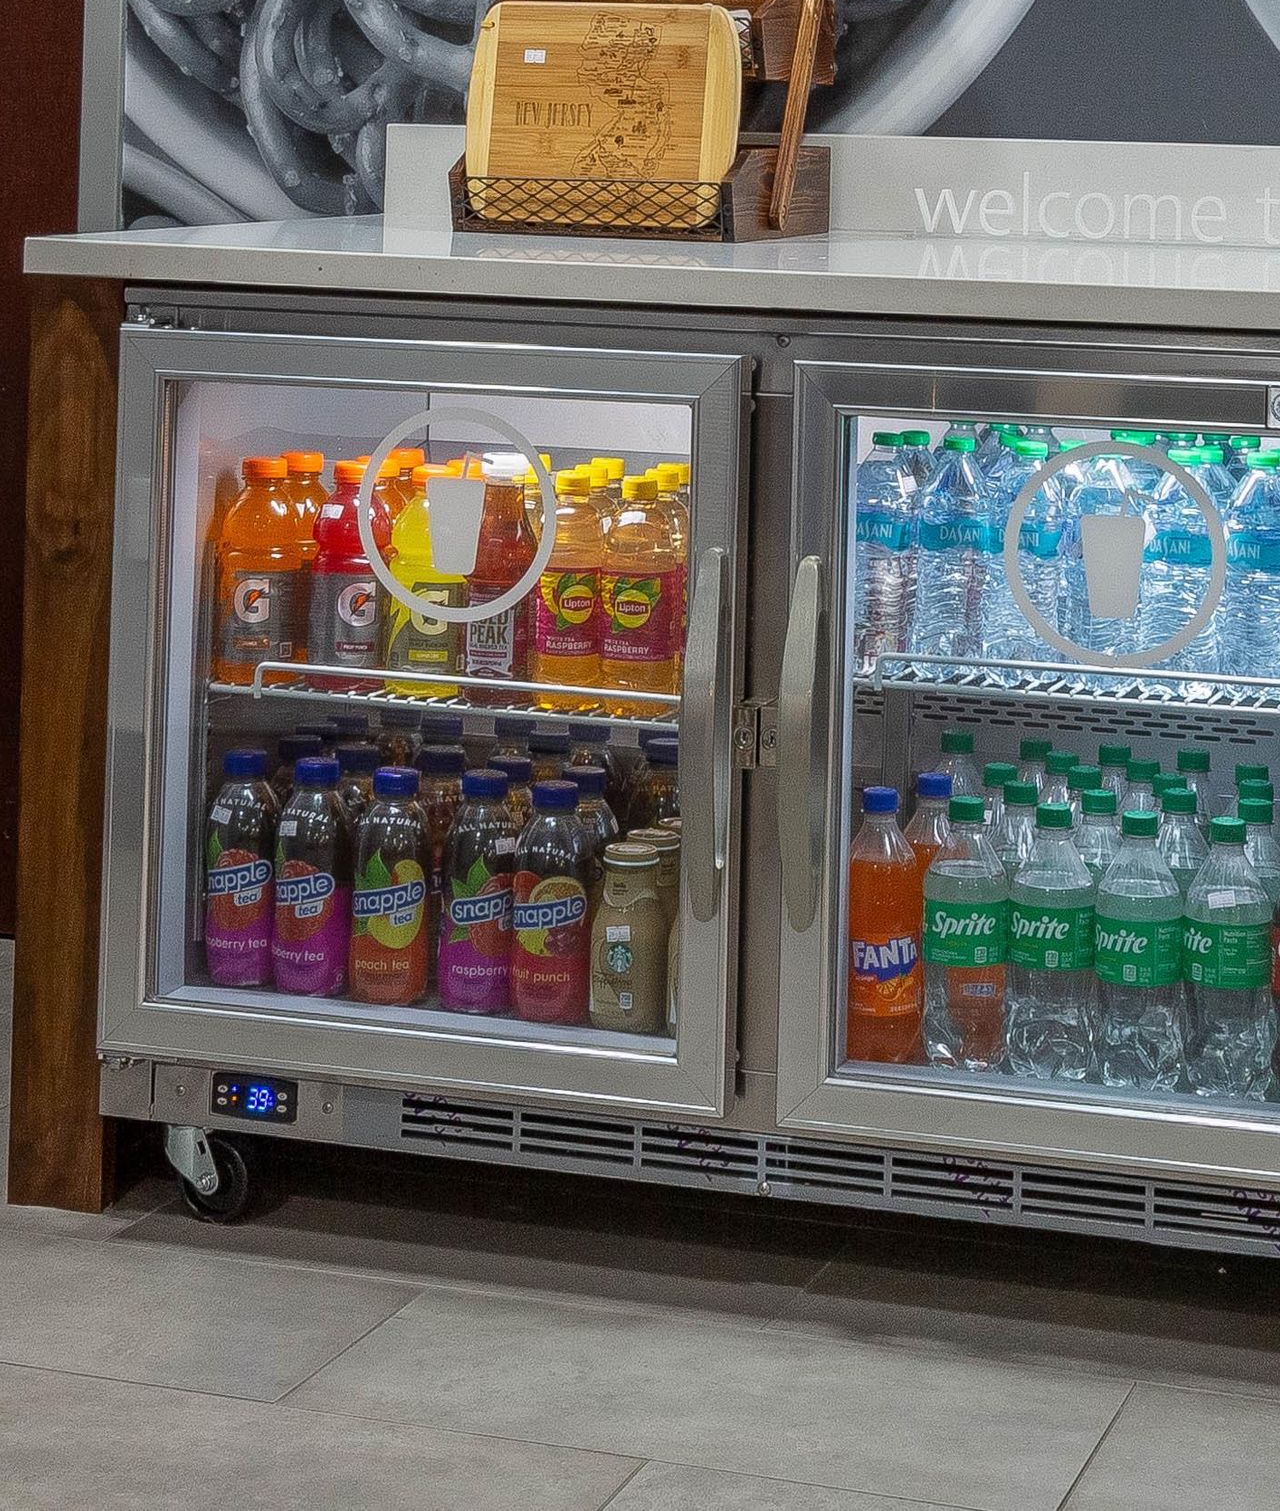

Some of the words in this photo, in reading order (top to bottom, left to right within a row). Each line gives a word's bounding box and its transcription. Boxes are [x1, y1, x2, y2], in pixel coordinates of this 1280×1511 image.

[515, 101, 543, 127] NEW
[546, 102, 593, 129] JERSEY
[914, 171, 1227, 243] welcome
[939, 525, 983, 546] DASANI
[1149, 538, 1191, 557] DASANI
[233, 578, 270, 623] G
[337, 581, 376, 627] G
[563, 599, 592, 610] Lipton
[618, 603, 646, 614] Lipton
[470, 624, 508, 644] PEAK
[545, 641, 593, 651] RASPBERRY
[604, 643, 650, 655] RASPBERRY
[220, 797, 268, 811] NATURAL
[372, 817, 421, 829] NATURAL
[531, 845, 577, 862] NATURAL
[208, 863, 268, 894] napple
[237, 892, 258, 904] tea
[354, 884, 423, 913] snapple
[393, 913, 413, 926] tea
[298, 903, 319, 916] tea
[513, 897, 584, 928] snapple
[932, 911, 996, 939] Sprite
[1011, 911, 1070, 939] Sprite
[248, 937, 267, 948] tea
[1095, 924, 1148, 954] Sprite
[304, 949, 325, 962] tea
[852, 937, 917, 970] FANTA
[355, 959, 387, 972] peach
[392, 959, 410, 970] tea
[451, 963, 508, 978] raspberry
[533, 970, 571, 984] punch
[247, 1088, 269, 1110] 39
